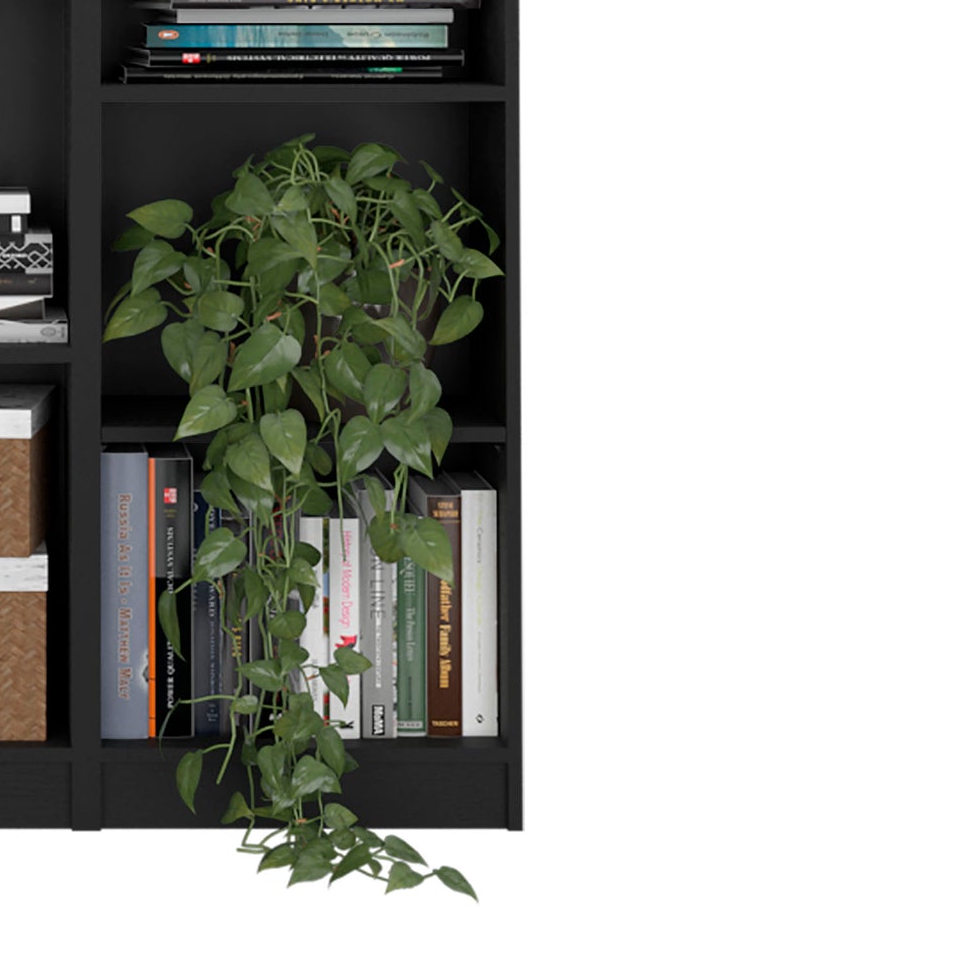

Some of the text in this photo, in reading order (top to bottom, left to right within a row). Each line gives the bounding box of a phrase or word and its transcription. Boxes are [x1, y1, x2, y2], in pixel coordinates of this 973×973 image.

[117, 492, 132, 543] Russia
[117, 542, 131, 562] As
[438, 623, 451, 657] Family
[439, 658, 451, 688] Album
